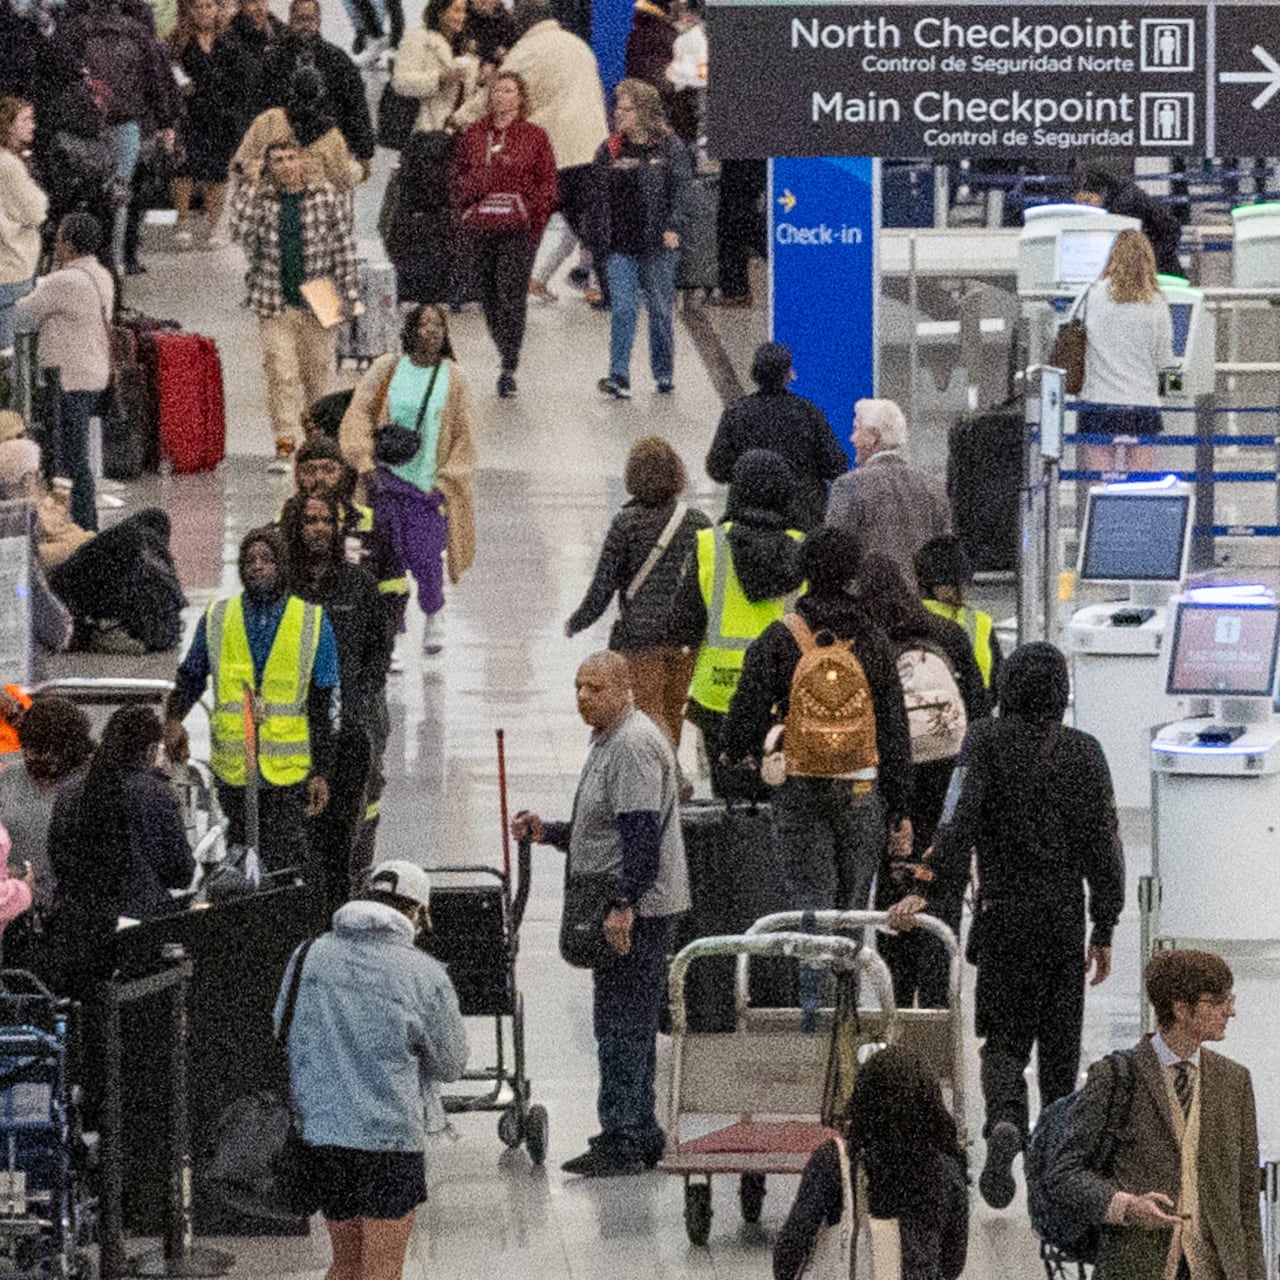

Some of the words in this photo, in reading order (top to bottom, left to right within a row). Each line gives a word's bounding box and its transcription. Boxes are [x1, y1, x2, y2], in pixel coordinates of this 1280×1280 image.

[791, 17, 900, 49] North
[913, 16, 1134, 53] Checkpoint
[861, 55, 936, 73] Control
[941, 55, 966, 72] de
[971, 55, 1073, 75] Seguridad
[1078, 56, 1134, 73] Norte
[811, 90, 900, 123] Main
[913, 90, 1134, 128] Checkpoint
[923, 129, 997, 147] Control
[1002, 129, 1028, 146] de
[1033, 129, 1134, 149] Seguridad
[775, 223, 863, 245] Check-in
